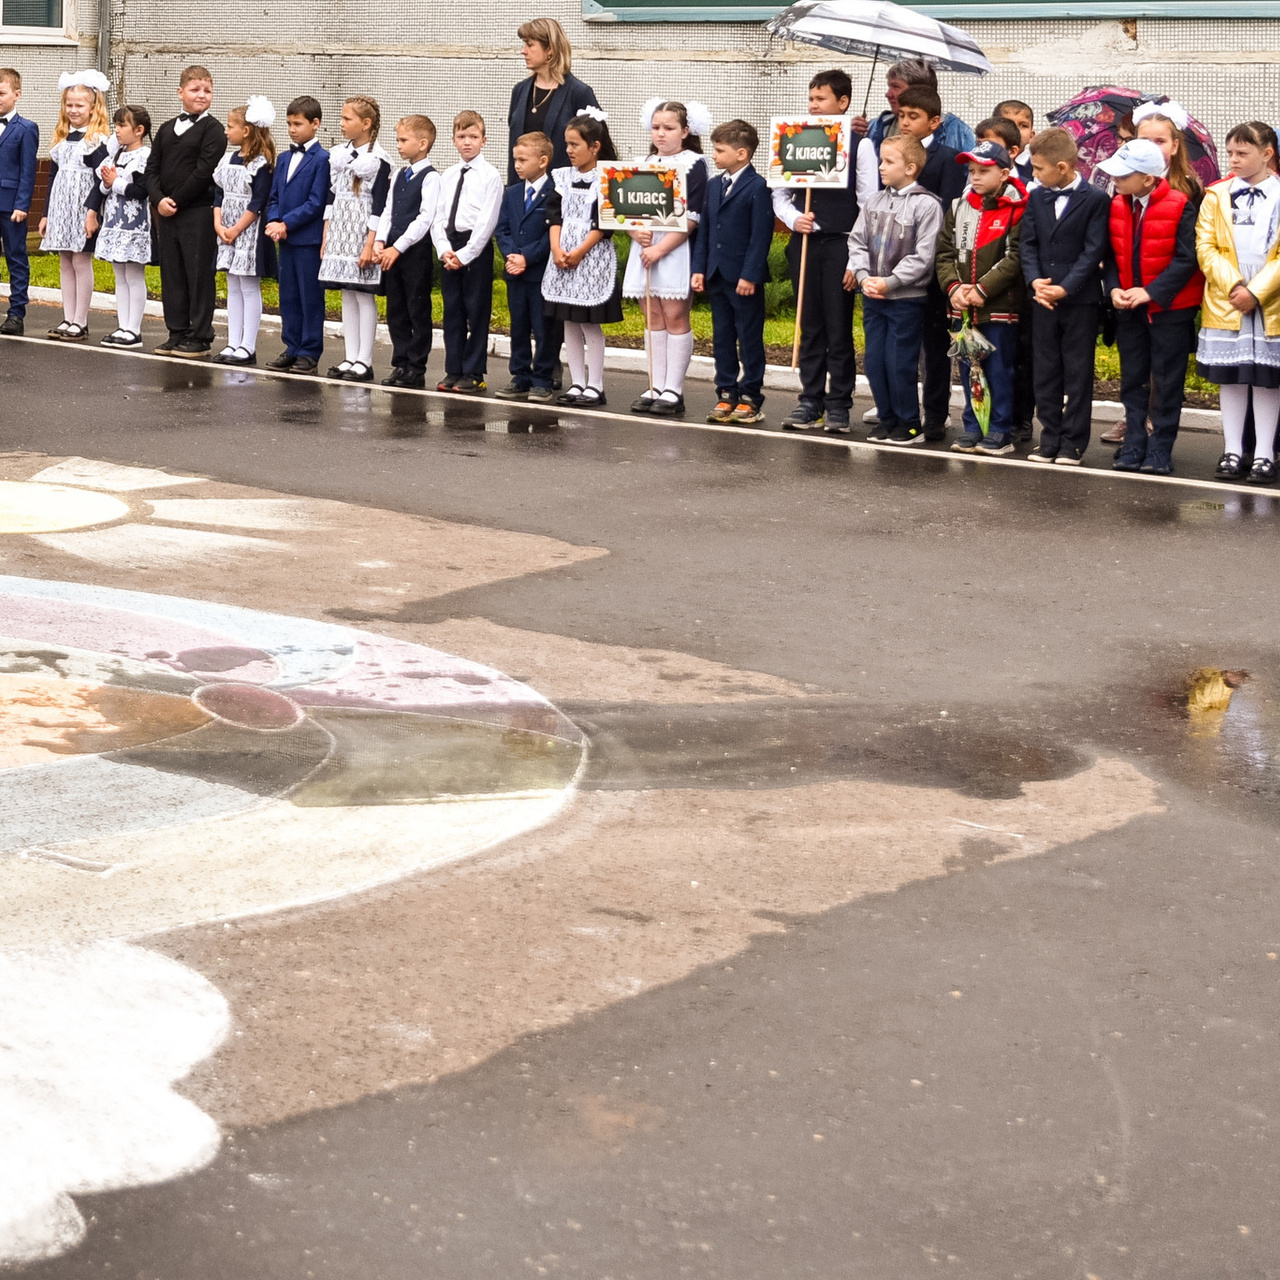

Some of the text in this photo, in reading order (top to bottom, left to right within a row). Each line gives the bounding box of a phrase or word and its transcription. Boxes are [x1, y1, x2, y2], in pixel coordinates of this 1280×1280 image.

[785, 144, 832, 160] 2 класс
[617, 188, 667, 205] 1 класс
